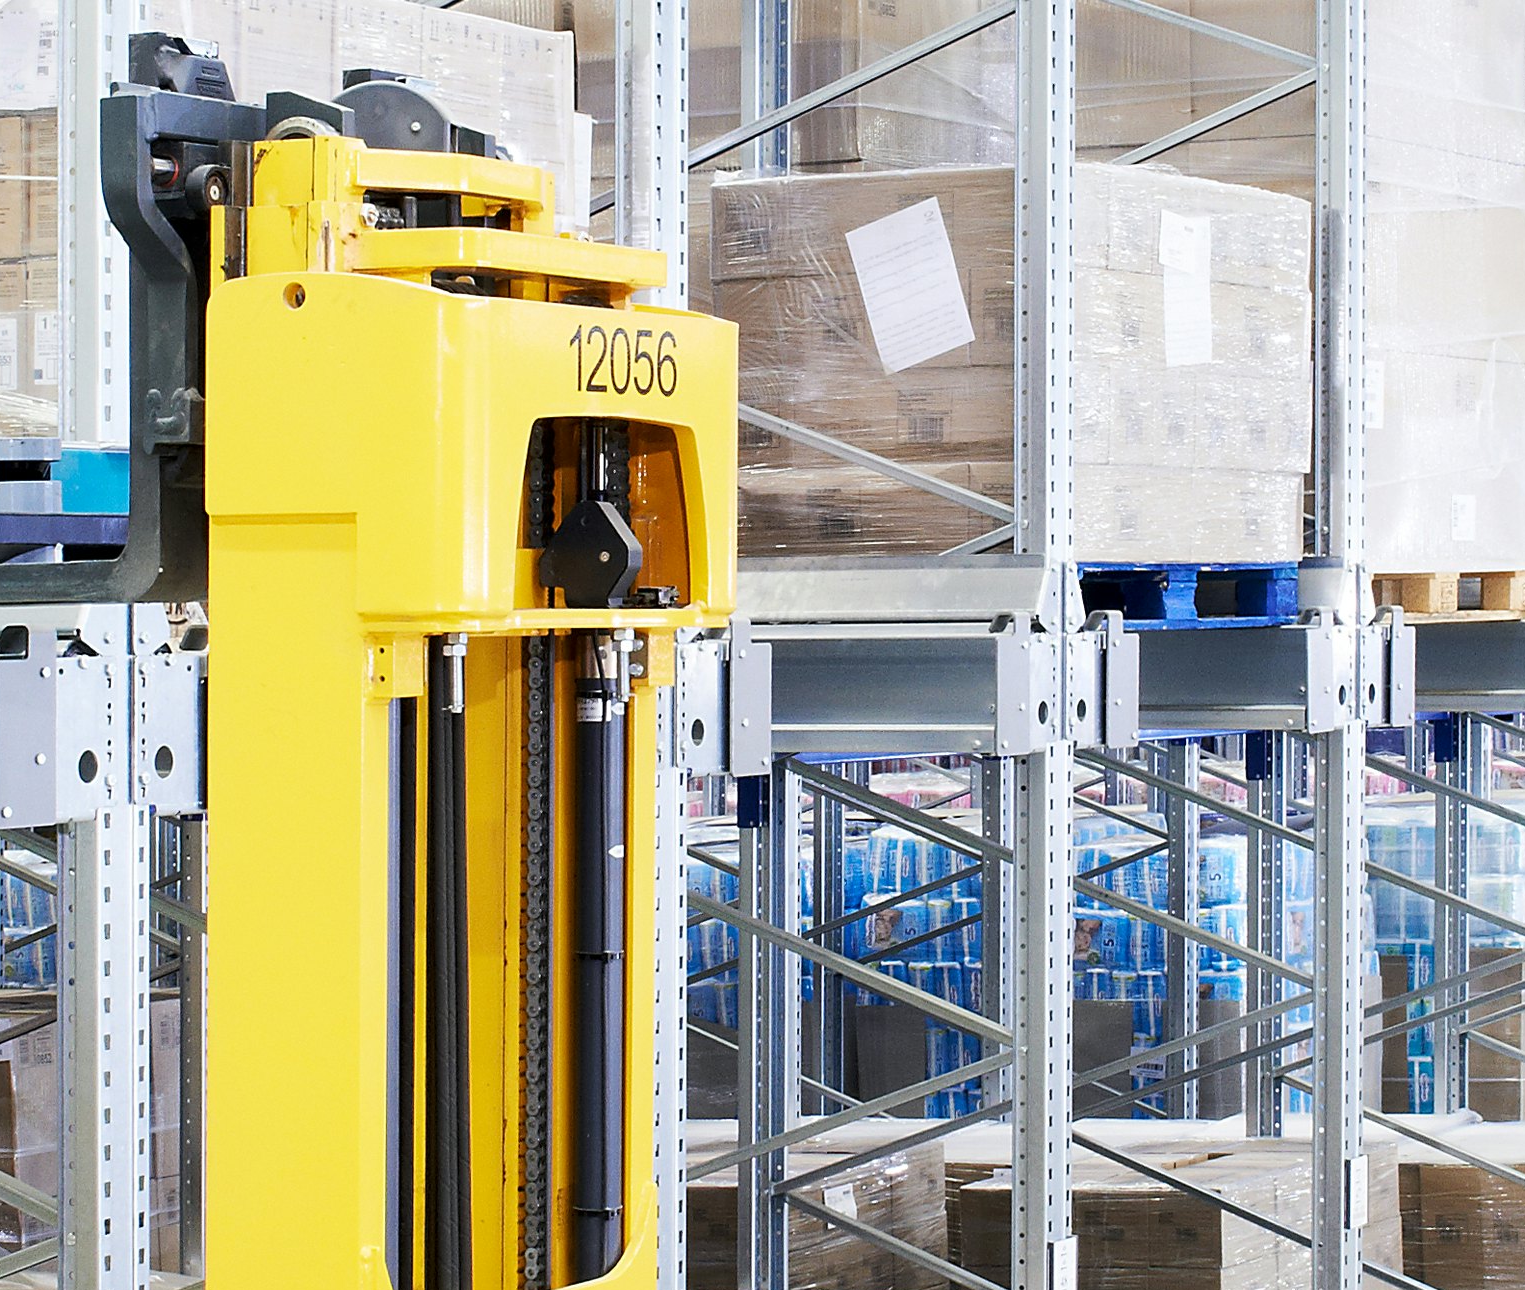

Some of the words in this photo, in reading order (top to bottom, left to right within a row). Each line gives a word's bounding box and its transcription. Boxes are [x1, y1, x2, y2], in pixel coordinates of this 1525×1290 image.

[569, 324, 677, 397] 12056
[1209, 873, 1221, 881] 5
[1103, 938, 1115, 947] 5
